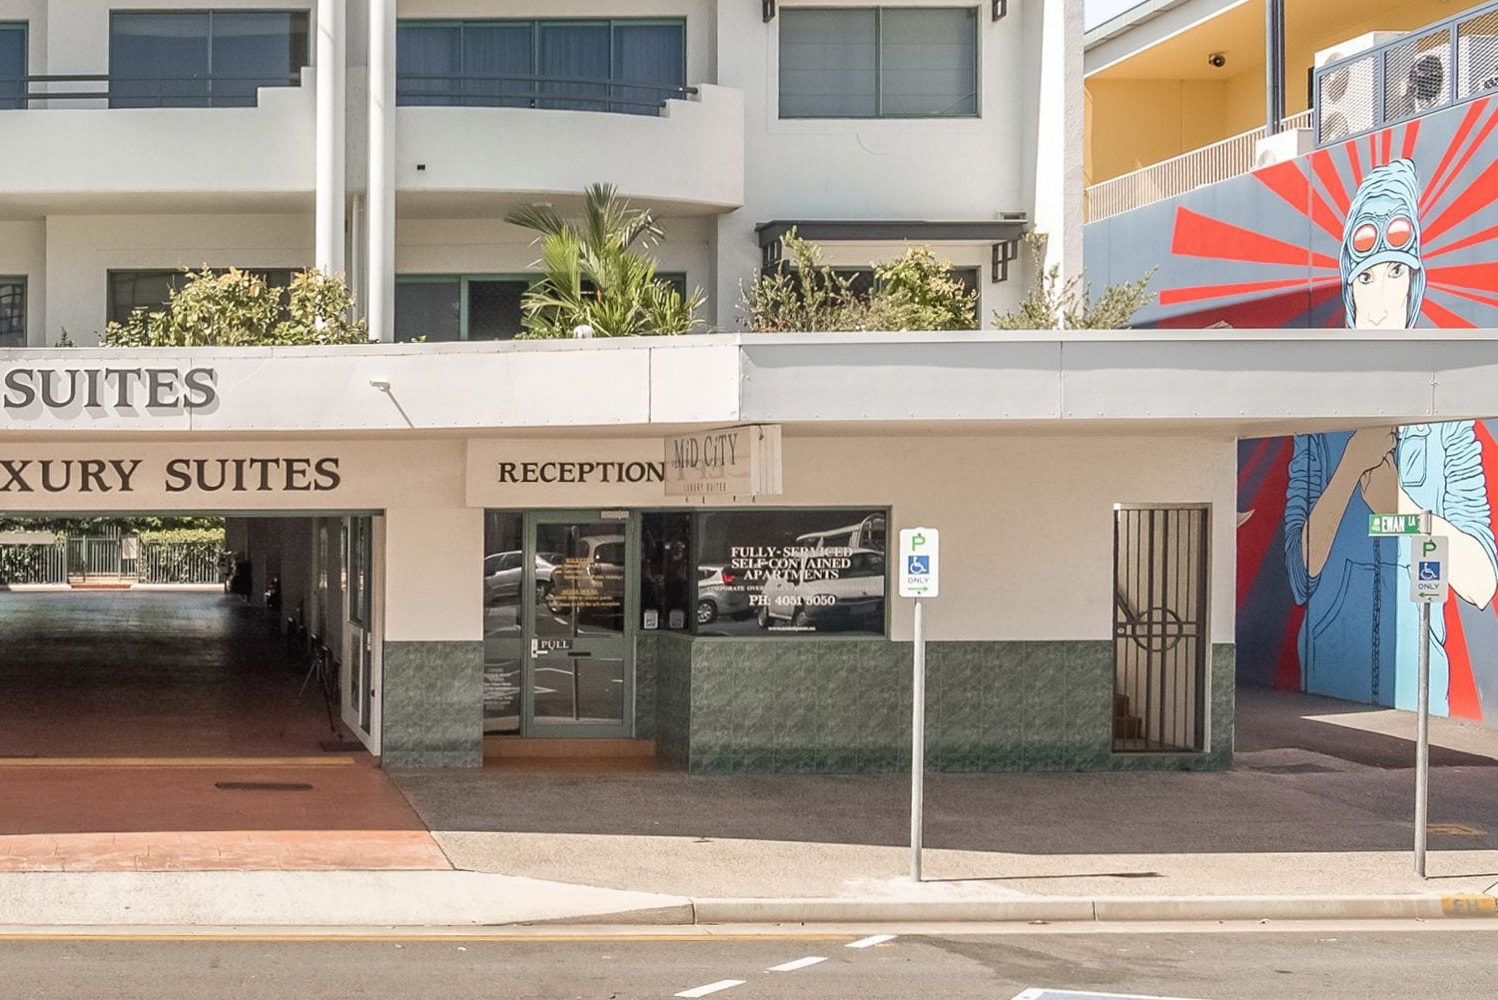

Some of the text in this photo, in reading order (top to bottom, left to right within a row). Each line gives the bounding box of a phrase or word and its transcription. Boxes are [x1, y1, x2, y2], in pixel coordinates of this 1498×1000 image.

[3, 367, 215, 409] SUITES
[164, 458, 341, 492] SUITES
[498, 461, 665, 483] RECEPTION
[1381, 515, 1405, 532] EWAN
[731, 547, 853, 557] FULLY-SERVICED
[731, 558, 851, 569] SELF-CONTAINED
[743, 570, 839, 580] APARTMENTS
[749, 595, 770, 606] PH:
[774, 595, 802, 606] 4051
[541, 640, 569, 650] PULL
